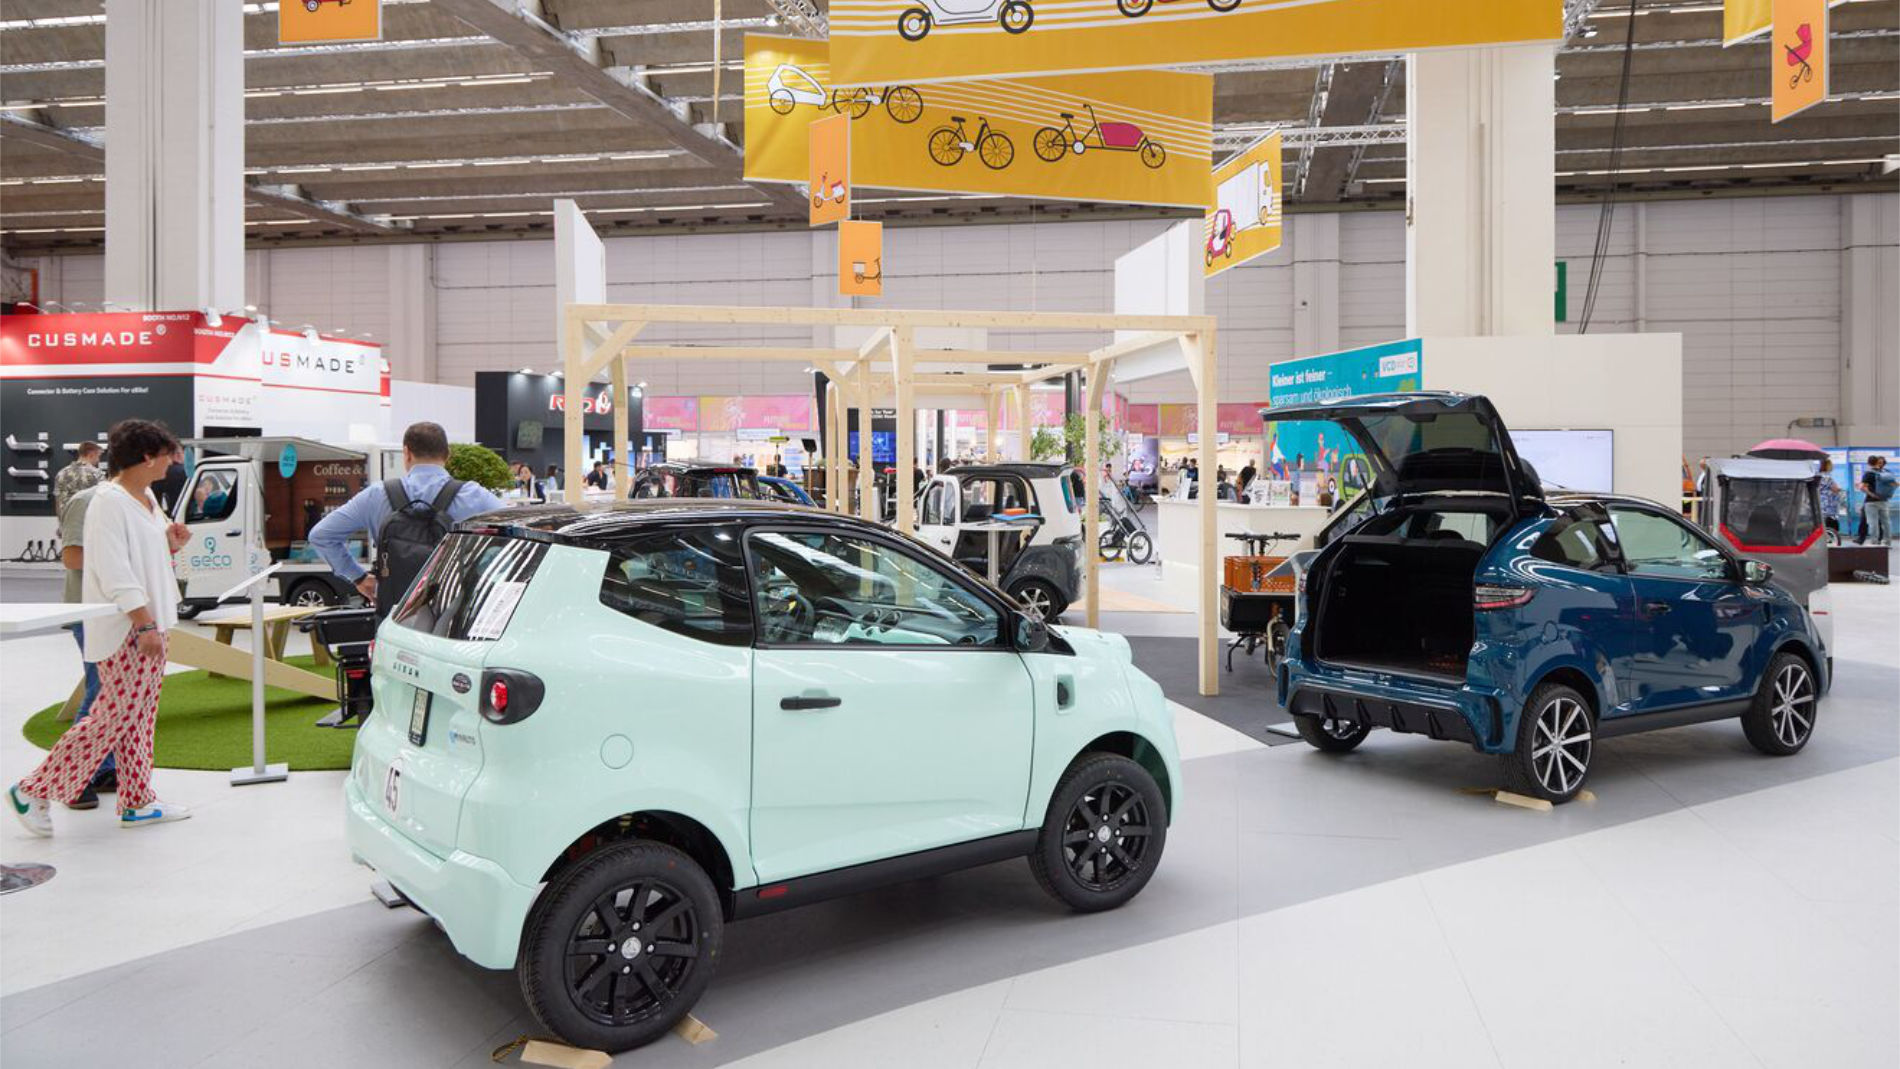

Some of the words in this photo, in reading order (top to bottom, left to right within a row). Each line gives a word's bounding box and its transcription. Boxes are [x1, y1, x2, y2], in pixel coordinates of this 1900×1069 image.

[27, 332, 152, 347] CUSMADE
[262, 350, 355, 373] USMADE
[1272, 373, 1294, 387] Kleiner
[1295, 371, 1304, 384] ist
[1305, 368, 1325, 383] feiner
[313, 464, 350, 476] Coffee
[352, 466, 362, 475] &
[386, 766, 401, 812] 45
